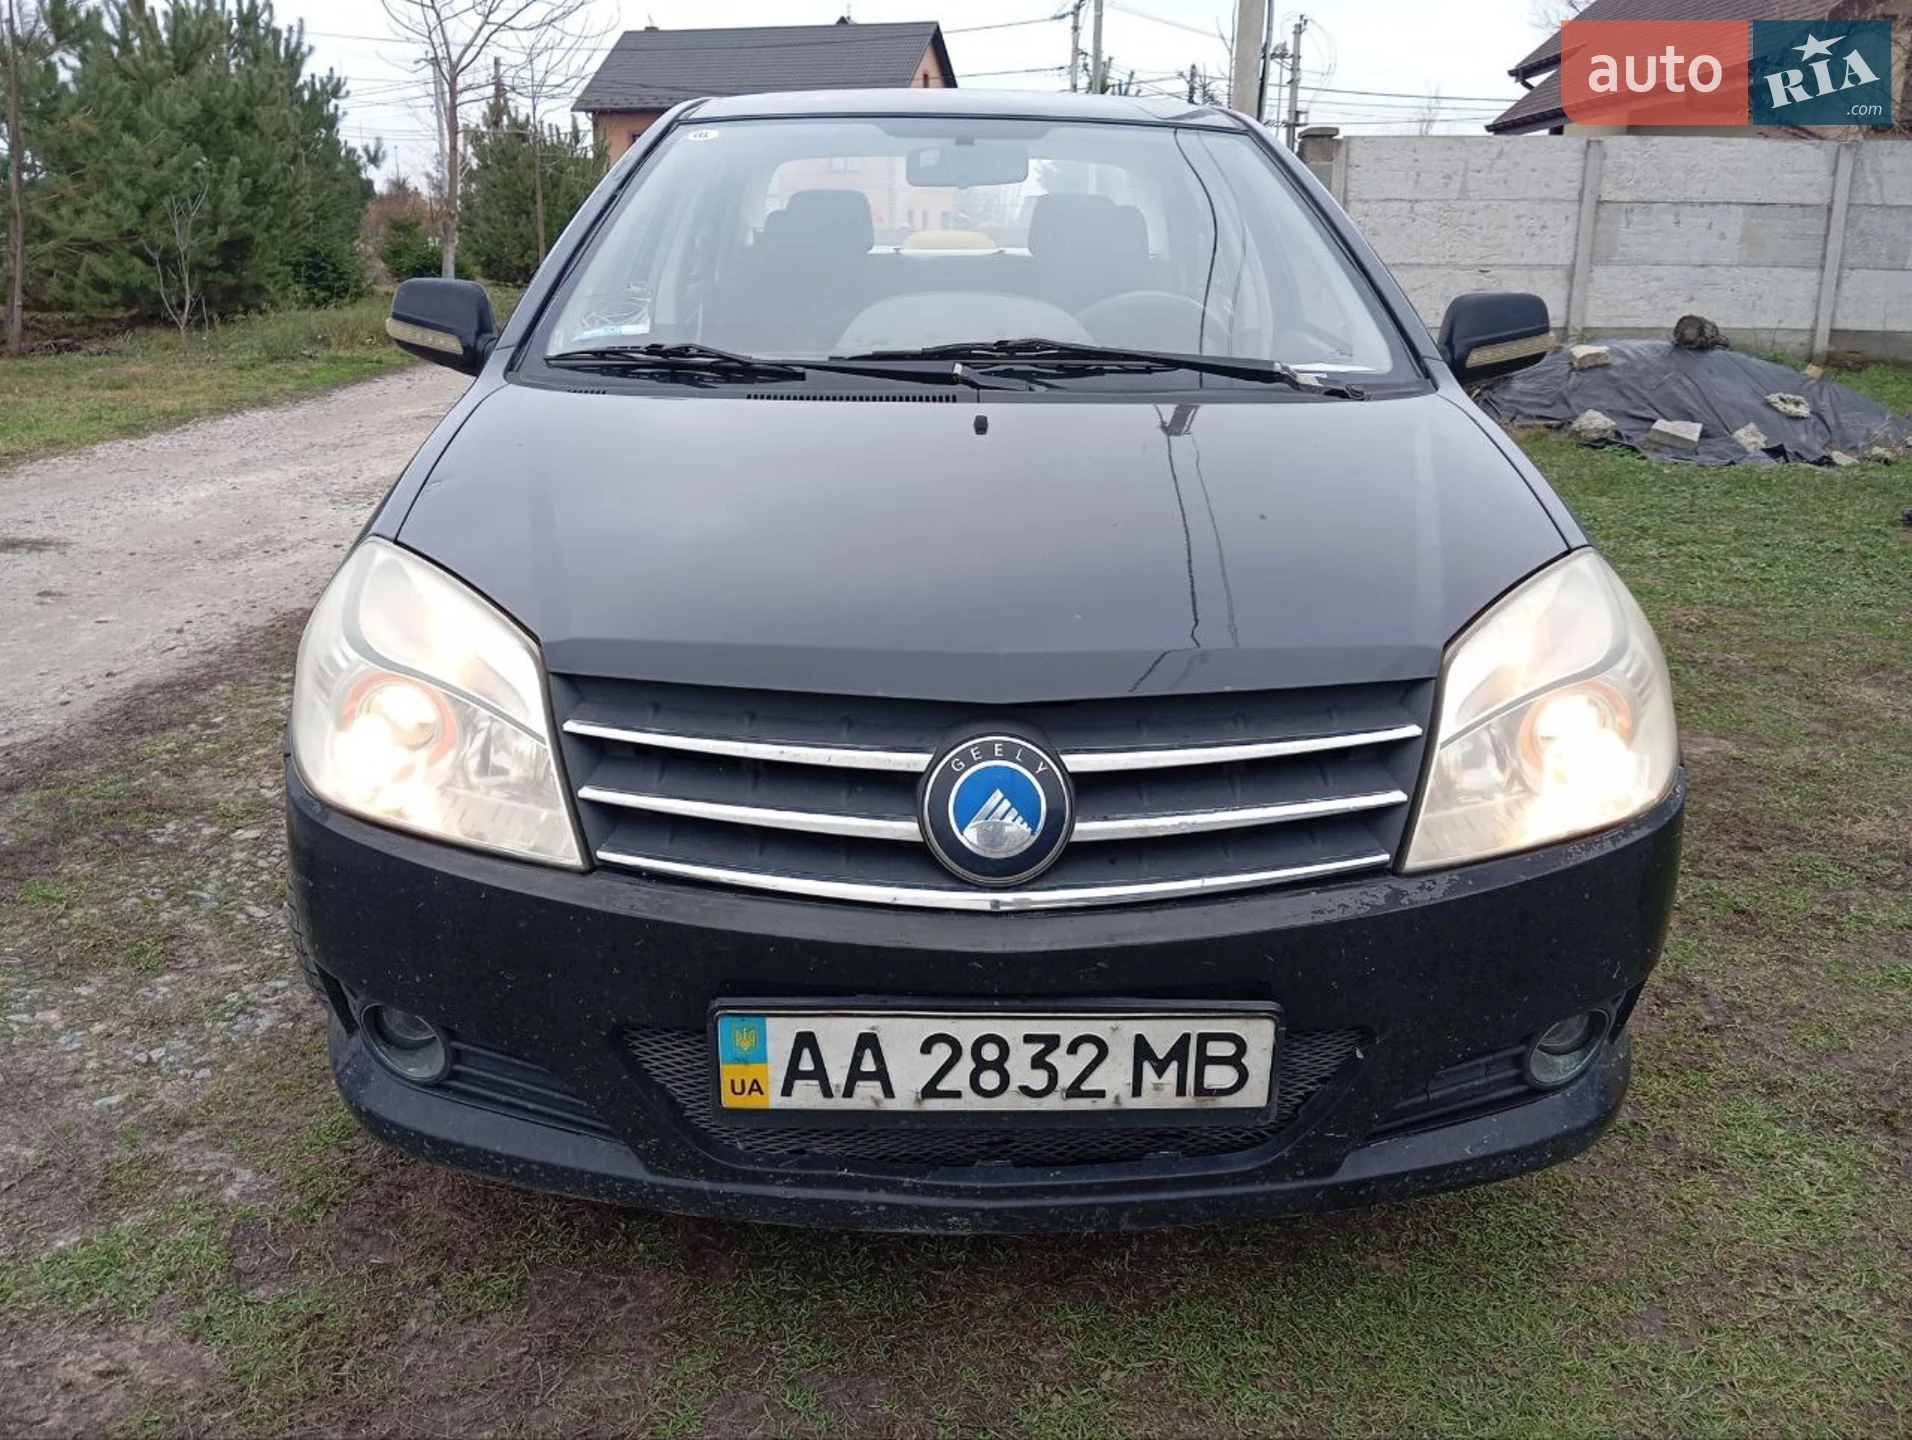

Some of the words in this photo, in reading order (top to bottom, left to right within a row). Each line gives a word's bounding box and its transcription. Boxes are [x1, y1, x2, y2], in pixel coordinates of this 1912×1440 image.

[950, 743, 1048, 775] GEELY
[780, 1031, 896, 1100] AA
[918, 1032, 1110, 1100] 2832
[1131, 1031, 1249, 1099] MB
[729, 1078, 765, 1097] UA
